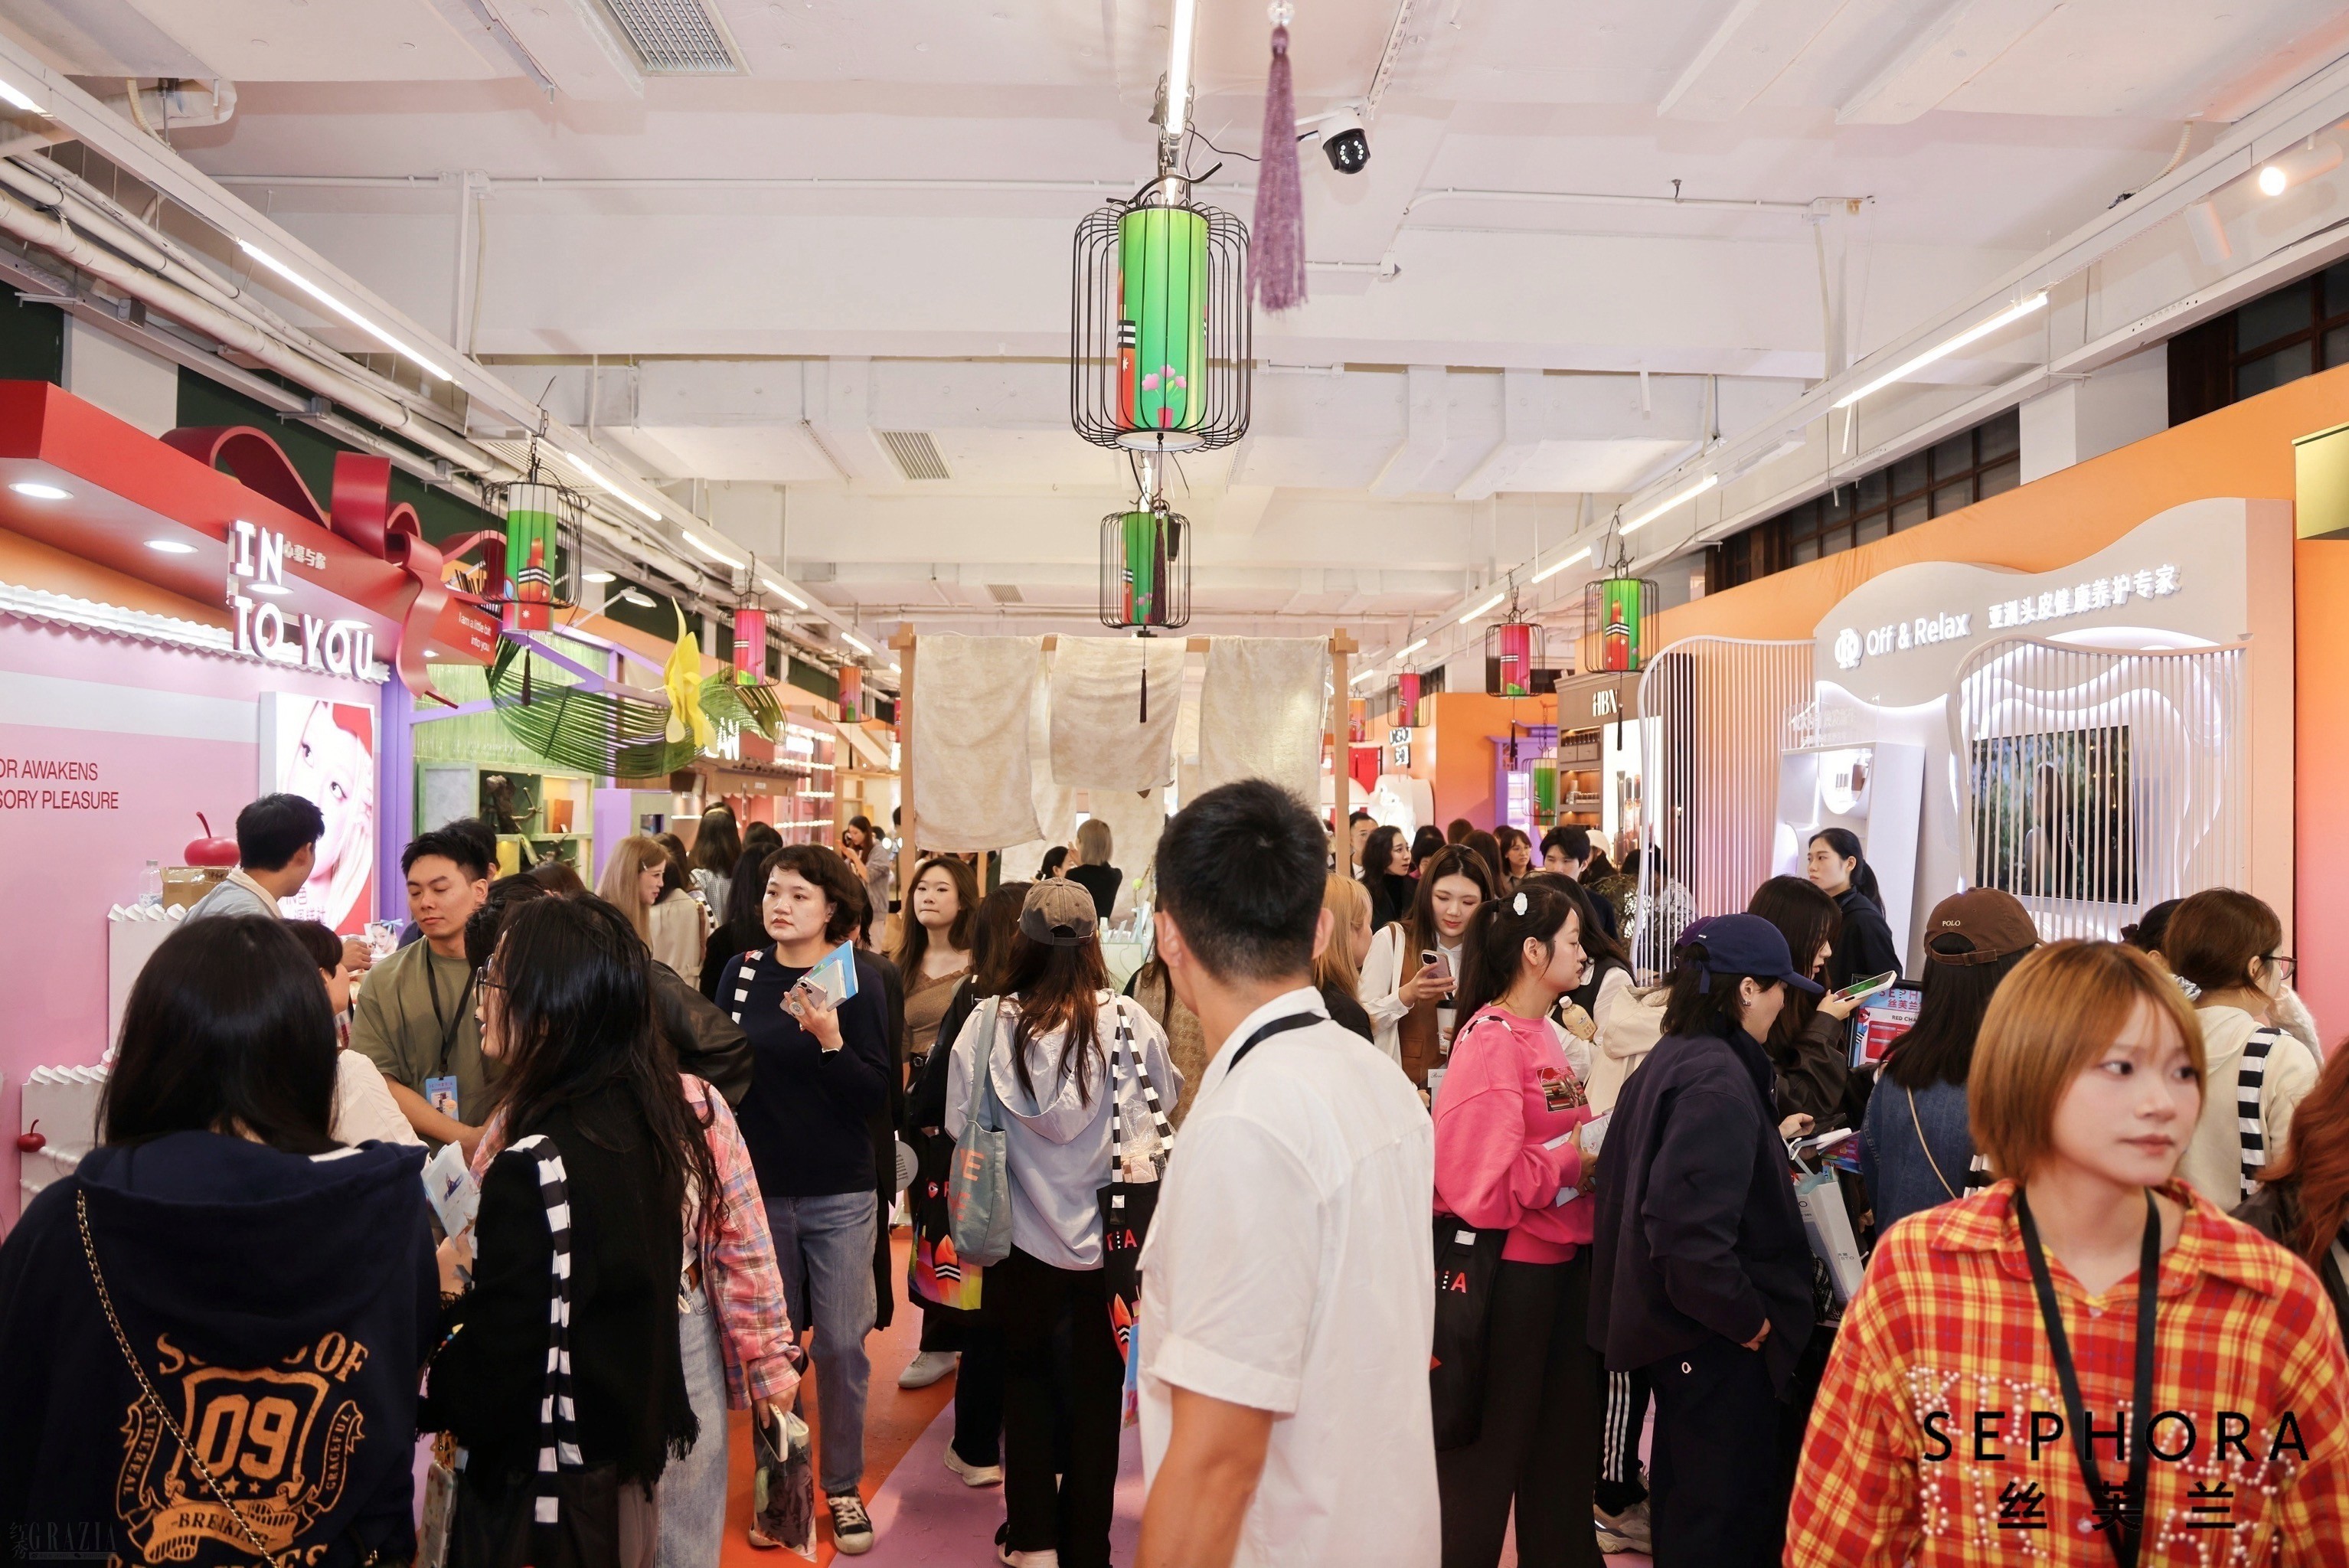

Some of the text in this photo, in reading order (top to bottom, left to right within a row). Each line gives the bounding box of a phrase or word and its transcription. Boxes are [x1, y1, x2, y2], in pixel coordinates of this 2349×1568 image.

[231, 520, 284, 586] IN
[1988, 564, 2179, 629] 亚洲头皮健康养护专家
[234, 595, 374, 680] TO YOU
[471, 635, 481, 648] into
[1866, 625, 1896, 656] Off
[1897, 622, 1912, 650] &
[1915, 612, 1972, 645] Relax
[21, 760, 98, 781] AWAKENS
[42, 790, 119, 809] PLEASURE
[1887, 998, 1918, 1010] 丝芙兰
[315, 1331, 369, 1383] OF
[190, 1393, 299, 1481] 09
[325, 1414, 351, 1491] GRACEFUL
